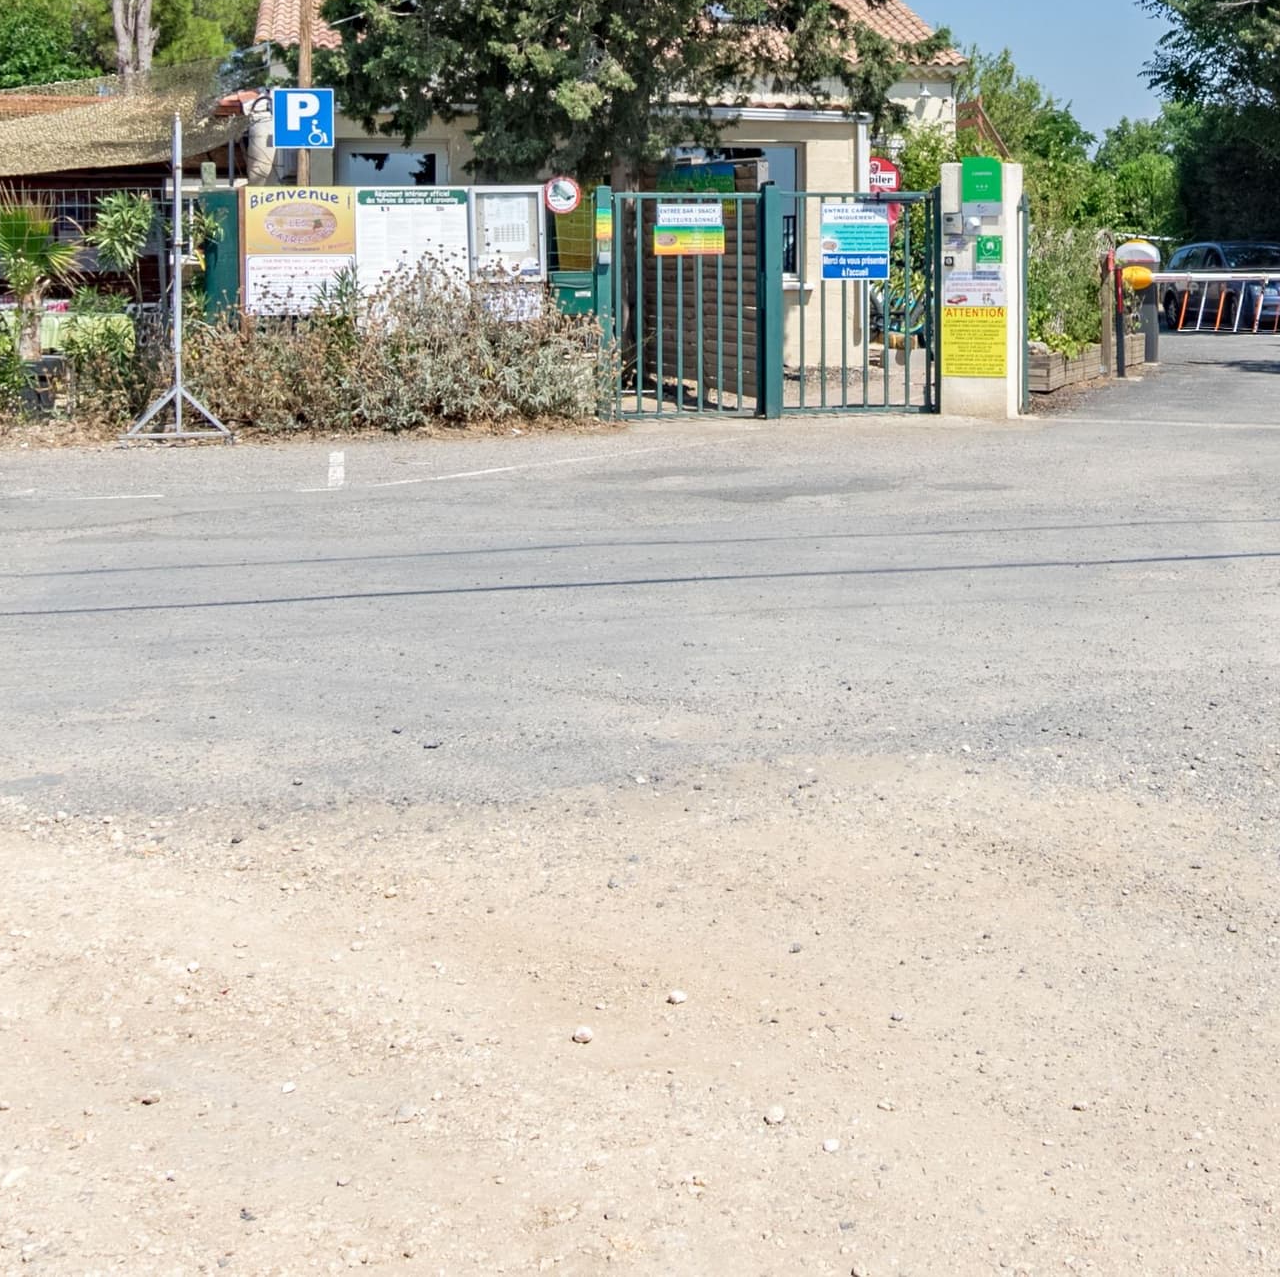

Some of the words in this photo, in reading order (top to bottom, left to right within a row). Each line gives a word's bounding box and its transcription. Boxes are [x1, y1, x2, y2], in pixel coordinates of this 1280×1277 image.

[287, 93, 320, 131] P
[869, 175, 893, 184] piler
[250, 189, 339, 209] Bienvenue
[946, 308, 1004, 318] ATTENTION
